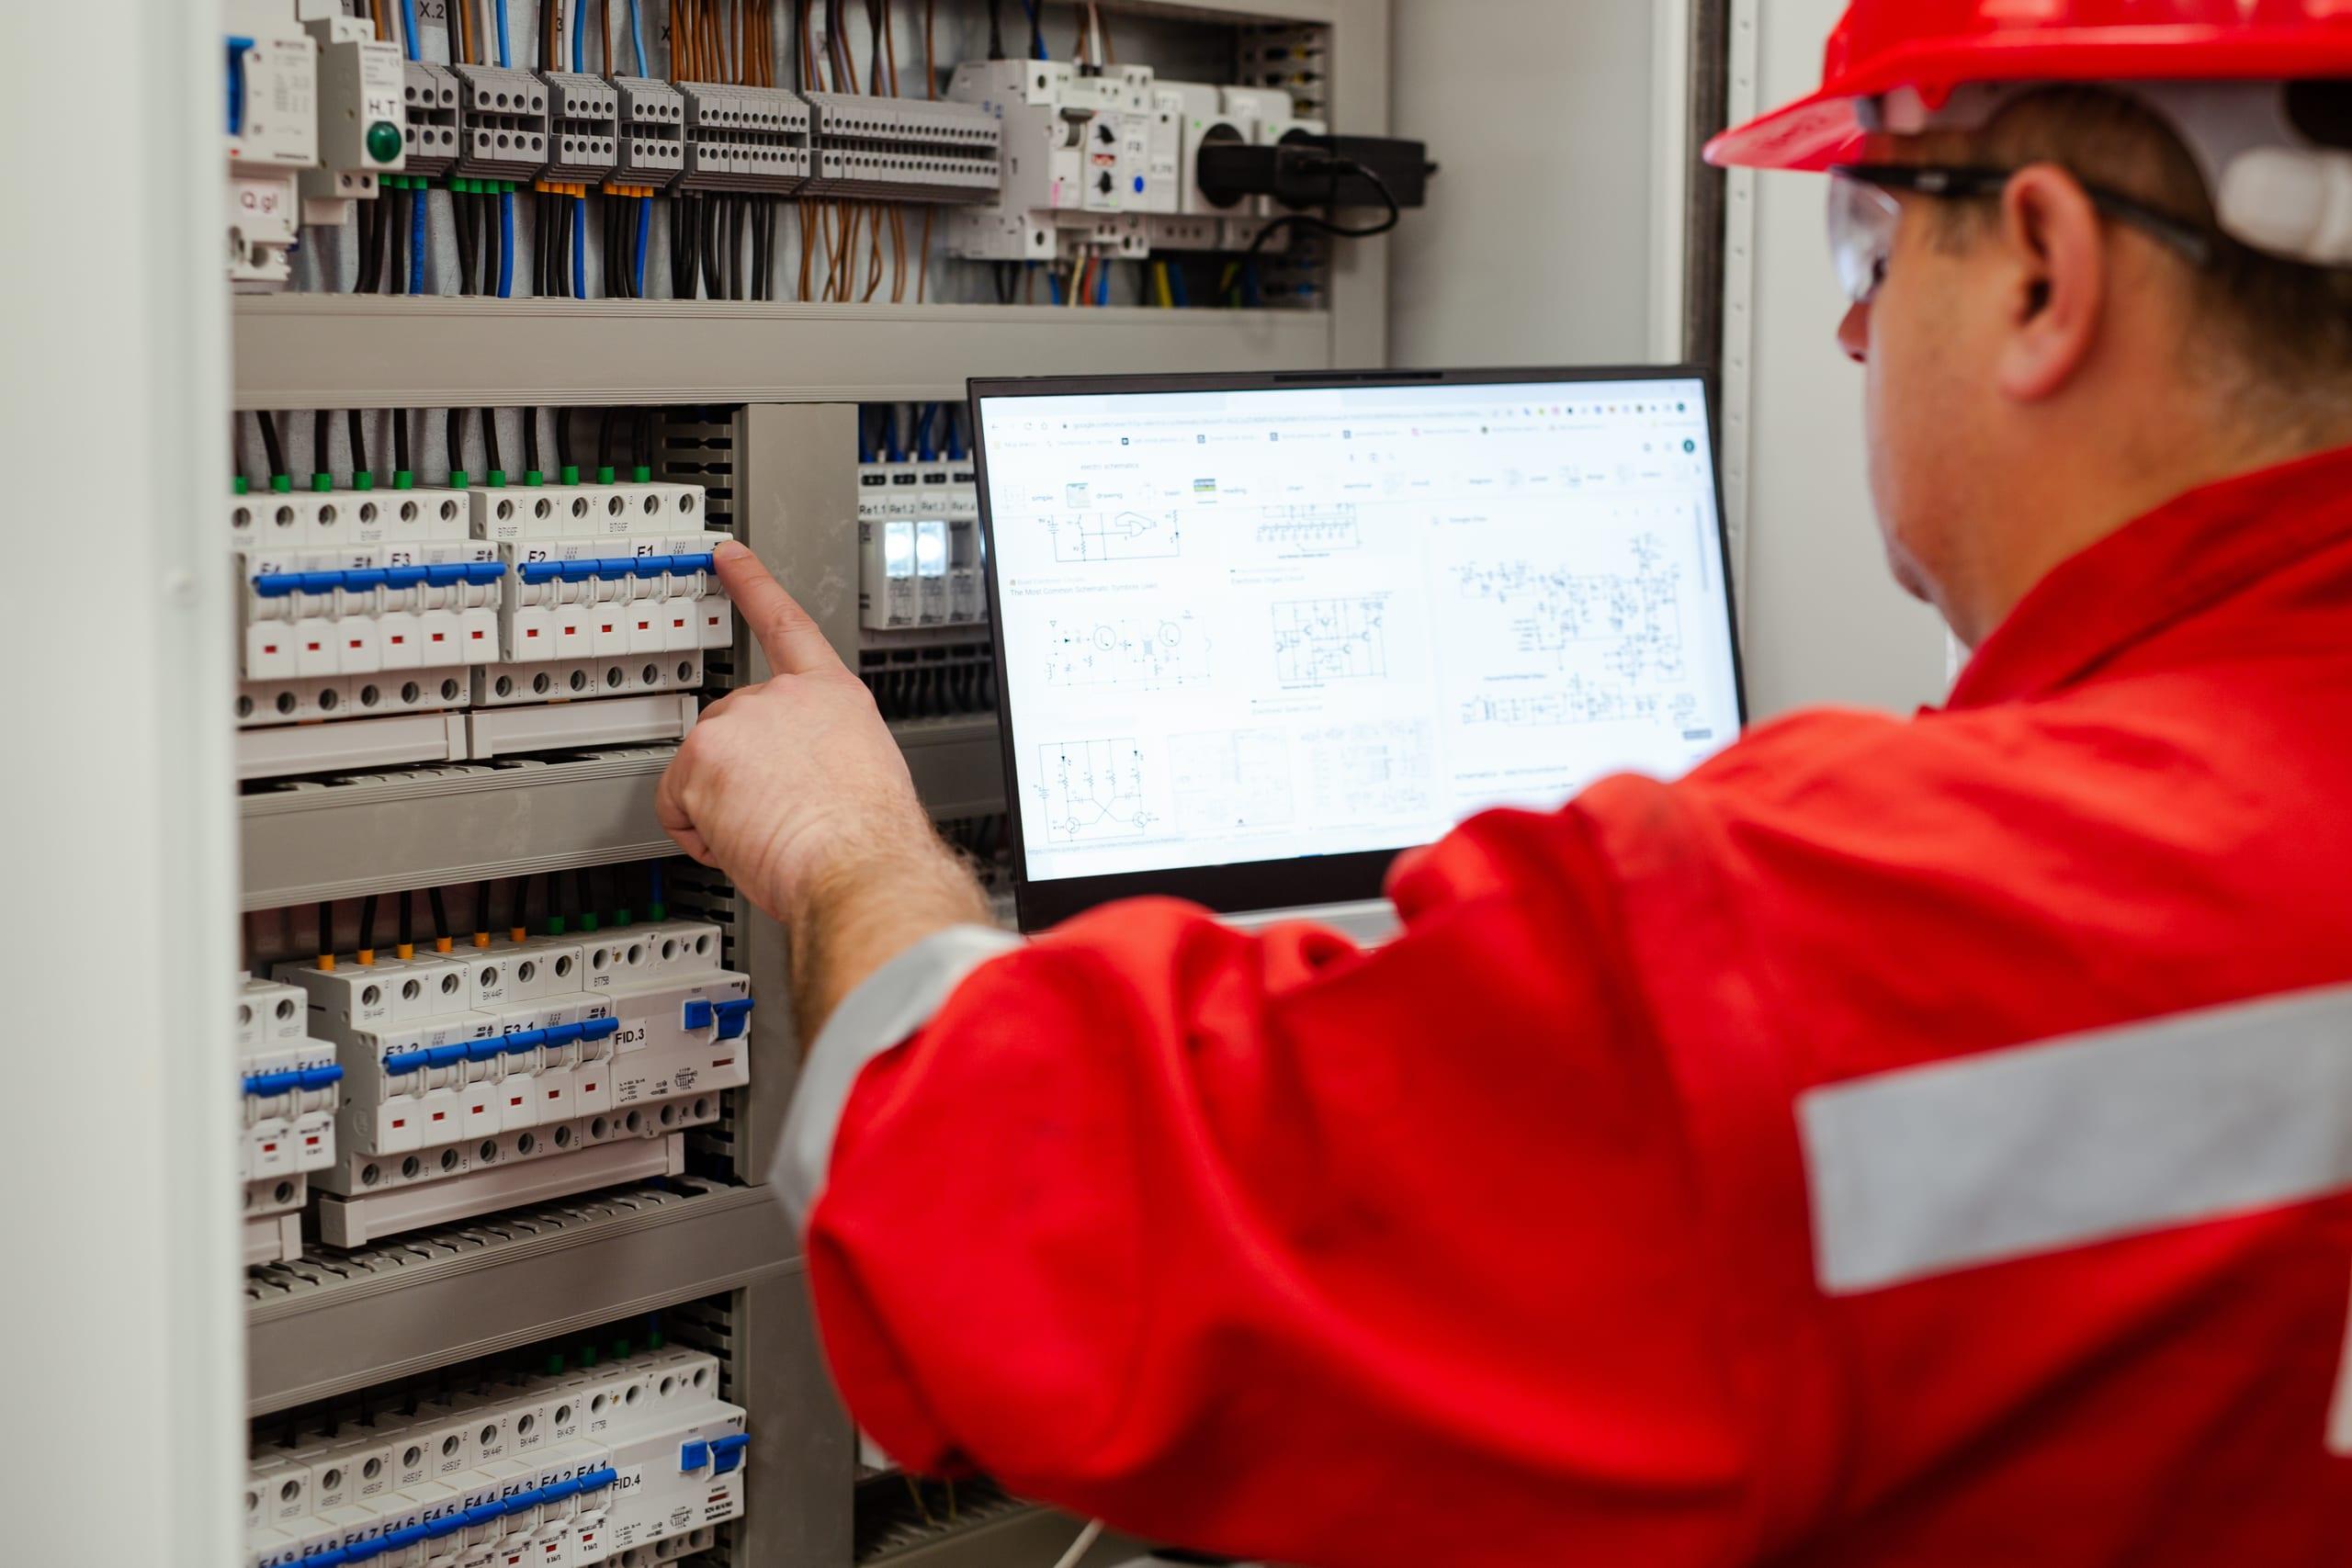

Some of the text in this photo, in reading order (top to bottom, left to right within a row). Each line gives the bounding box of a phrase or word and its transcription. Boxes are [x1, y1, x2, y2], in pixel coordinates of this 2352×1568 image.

[419, 2, 446, 19] X.2
[1024, 588, 1042, 596] Most
[503, 1021, 534, 1035] F31
[616, 1029, 645, 1045] FID.3
[386, 1043, 419, 1055] F32
[577, 1461, 606, 1477] F41
[541, 1471, 571, 1487] F42
[612, 1473, 641, 1492] FID.4
[503, 1481, 533, 1498] F43
[464, 1492, 495, 1510] F44
[423, 1505, 455, 1523] F45
[383, 1517, 415, 1534] F46
[344, 1528, 379, 1546] F47
[303, 1540, 338, 1557] F48
[258, 1552, 295, 1568] F49
